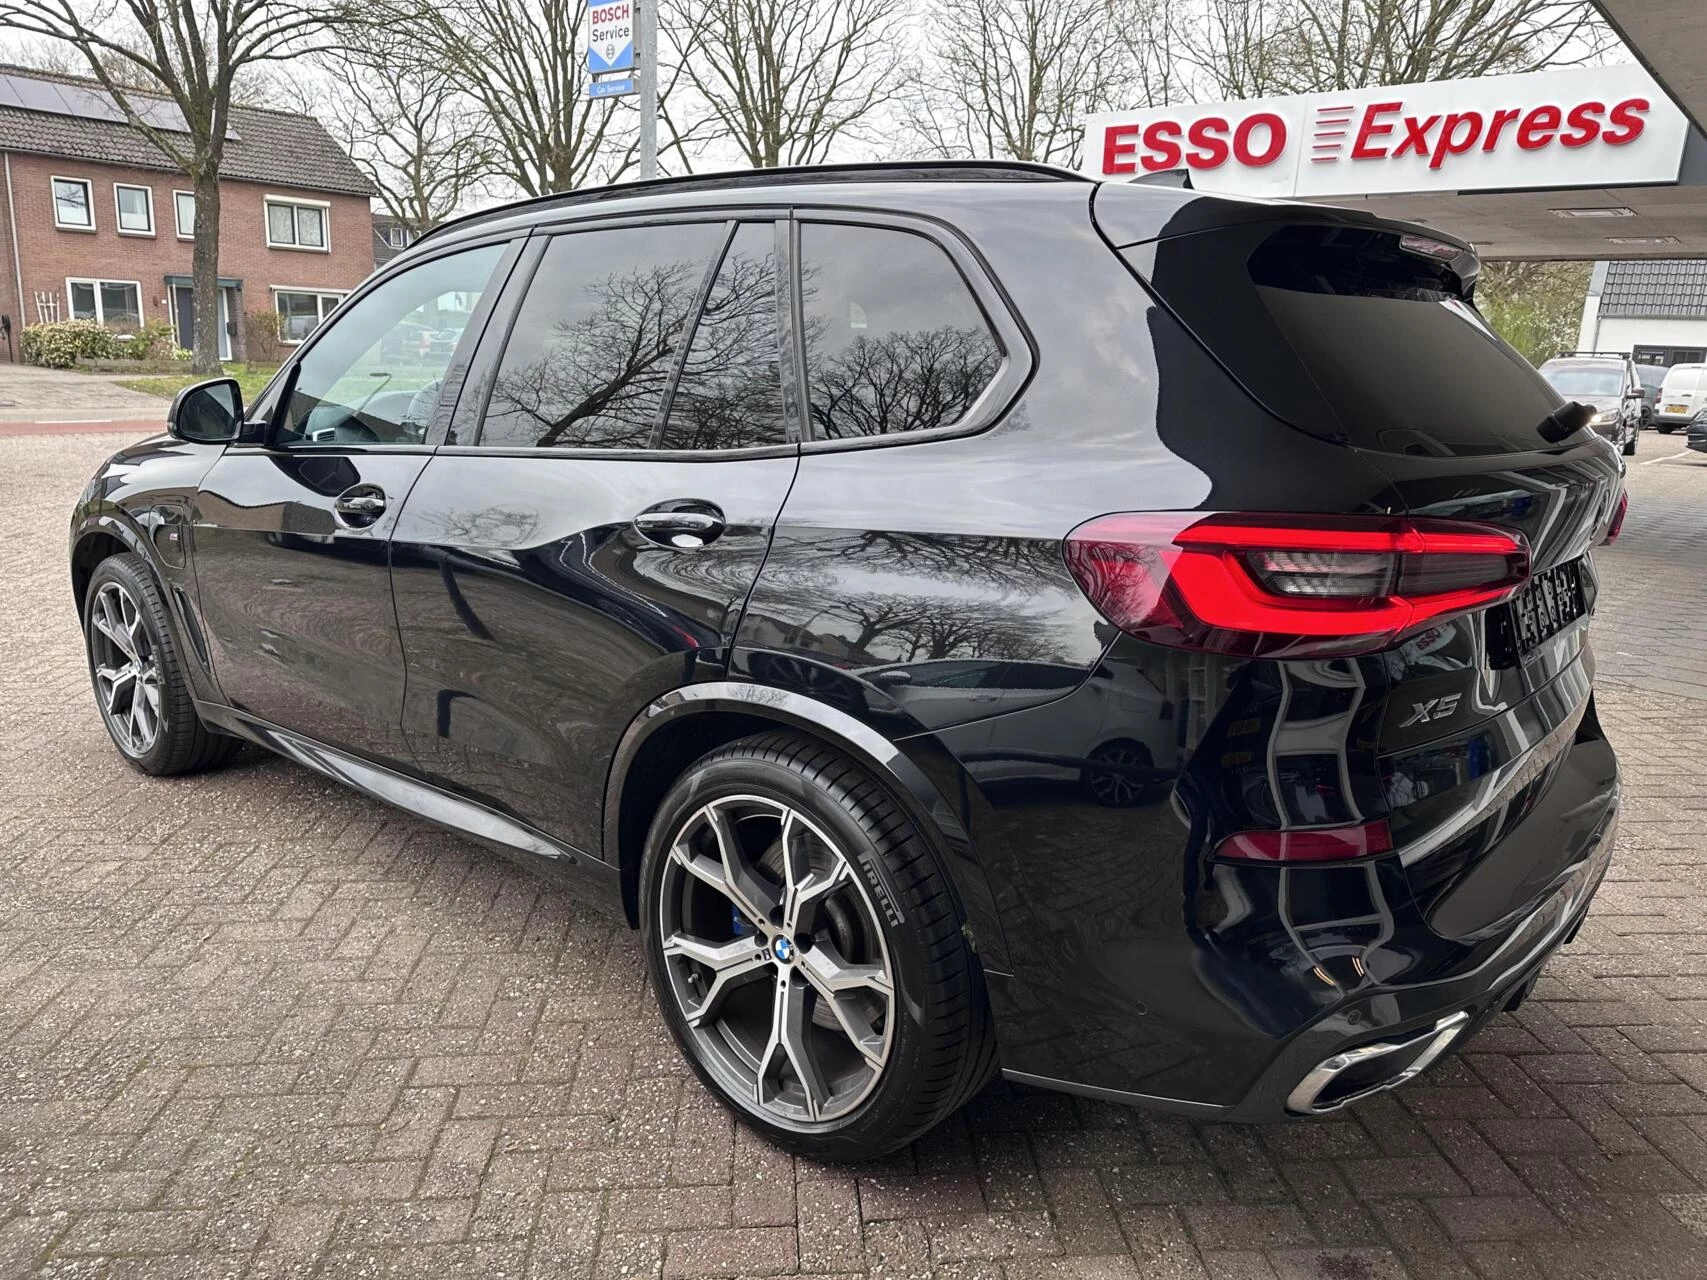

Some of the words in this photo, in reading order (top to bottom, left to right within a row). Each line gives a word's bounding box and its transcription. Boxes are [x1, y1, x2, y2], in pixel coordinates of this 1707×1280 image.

[592, 4, 630, 25] BOSCH
[592, 26, 630, 42] Service
[1102, 112, 1287, 175] ESSO
[1350, 98, 1650, 170] Express
[1399, 692, 1462, 728] X5
[857, 850, 905, 928] PIRELLI
